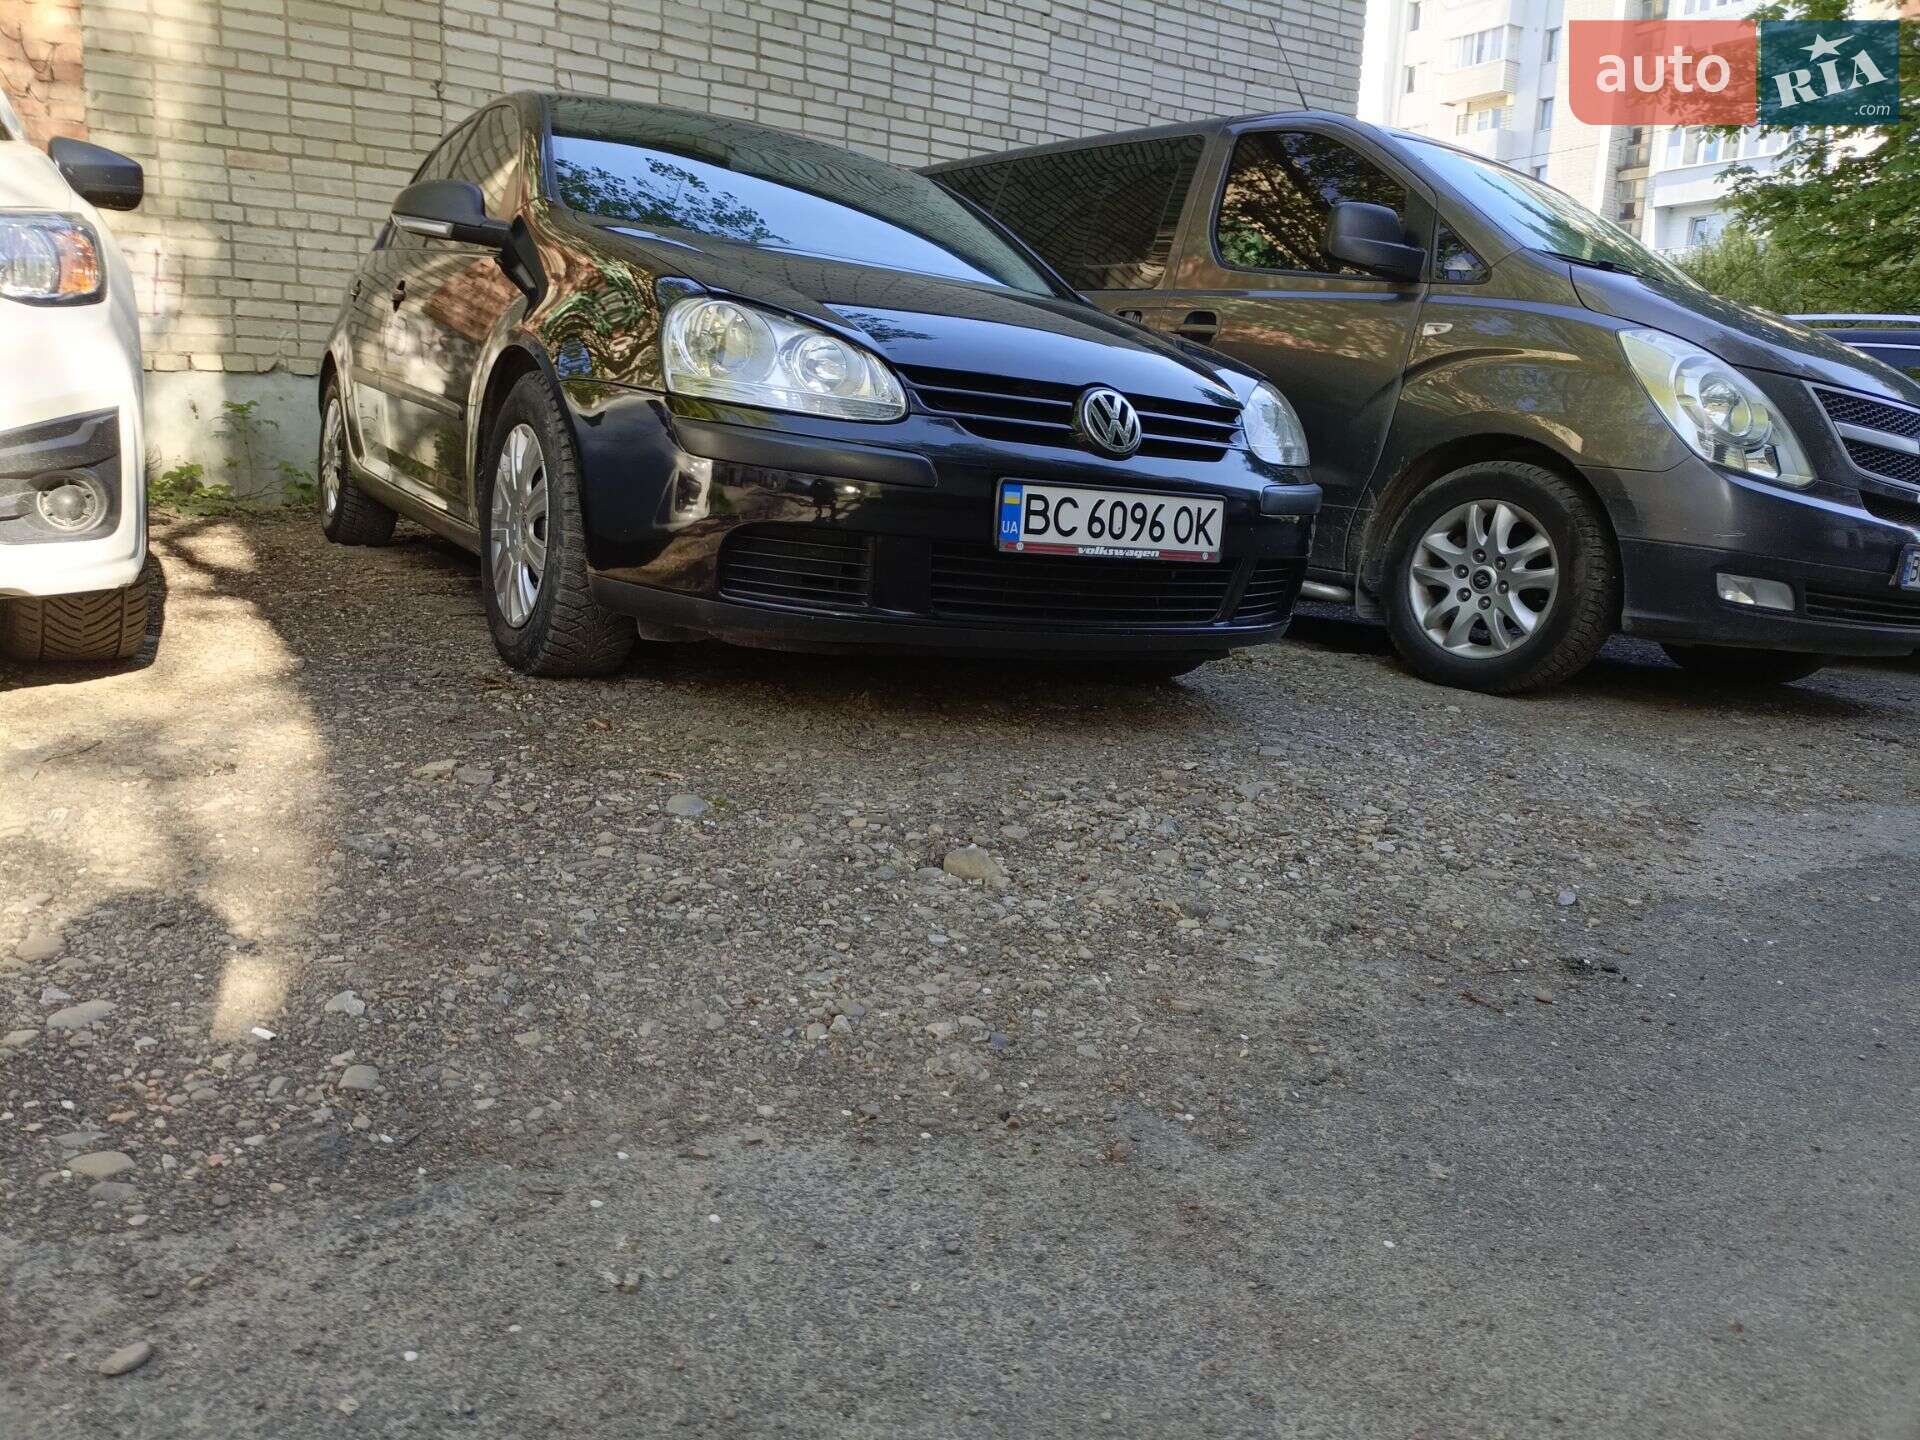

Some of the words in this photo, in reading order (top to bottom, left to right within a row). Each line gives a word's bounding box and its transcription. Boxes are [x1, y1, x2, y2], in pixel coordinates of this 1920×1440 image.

[1023, 493, 1079, 537] BC
[1087, 498, 1165, 543] 6096
[1173, 505, 1217, 546] OK
[1001, 520, 1019, 534] UA
[1078, 545, 1160, 559] volkswagen
